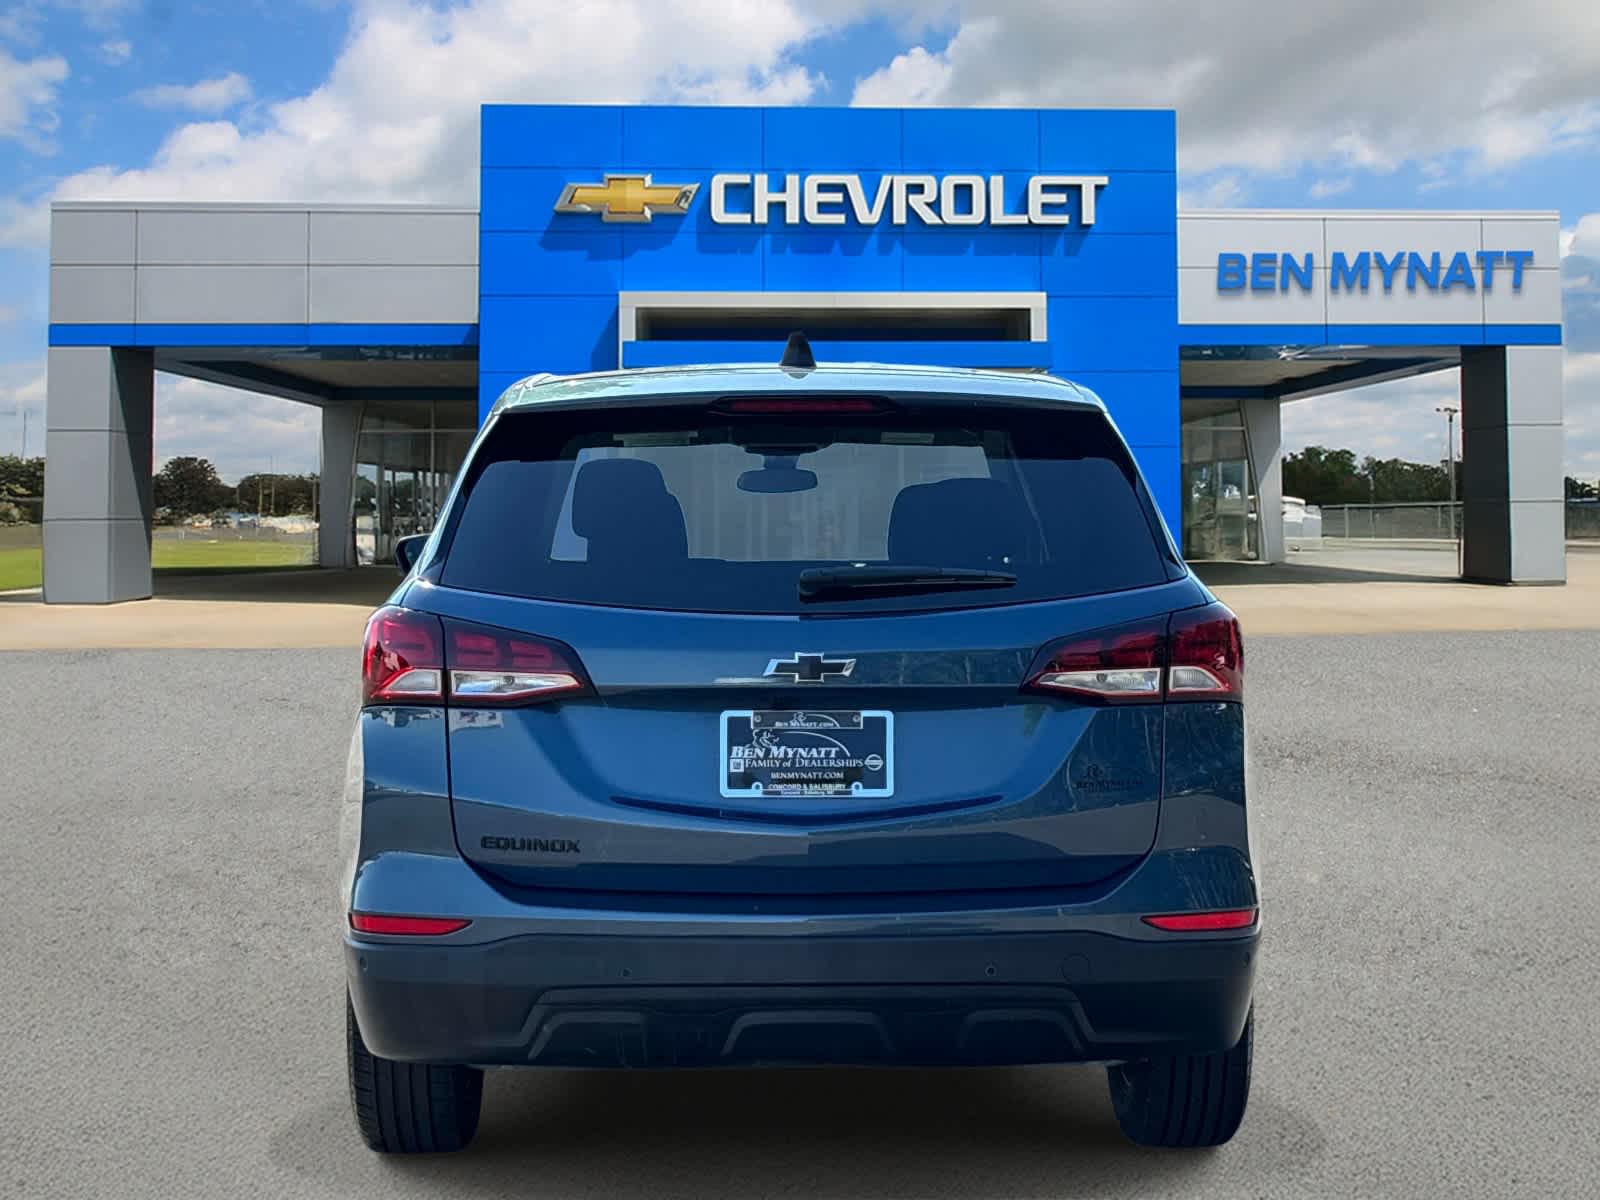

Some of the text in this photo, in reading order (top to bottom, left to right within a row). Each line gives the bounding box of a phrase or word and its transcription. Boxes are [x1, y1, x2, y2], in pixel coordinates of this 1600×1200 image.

[711, 173, 1109, 225] CHEVROLET
[1217, 250, 1533, 291] BEN MYNATT
[730, 745, 840, 759] BEN MYNATT
[745, 759, 781, 769] FAMILY
[782, 759, 792, 768] of
[795, 758, 864, 768] DEALERSHIPS
[771, 771, 845, 780] BENMYNATT.COM
[480, 836, 581, 853] EQUINOX
